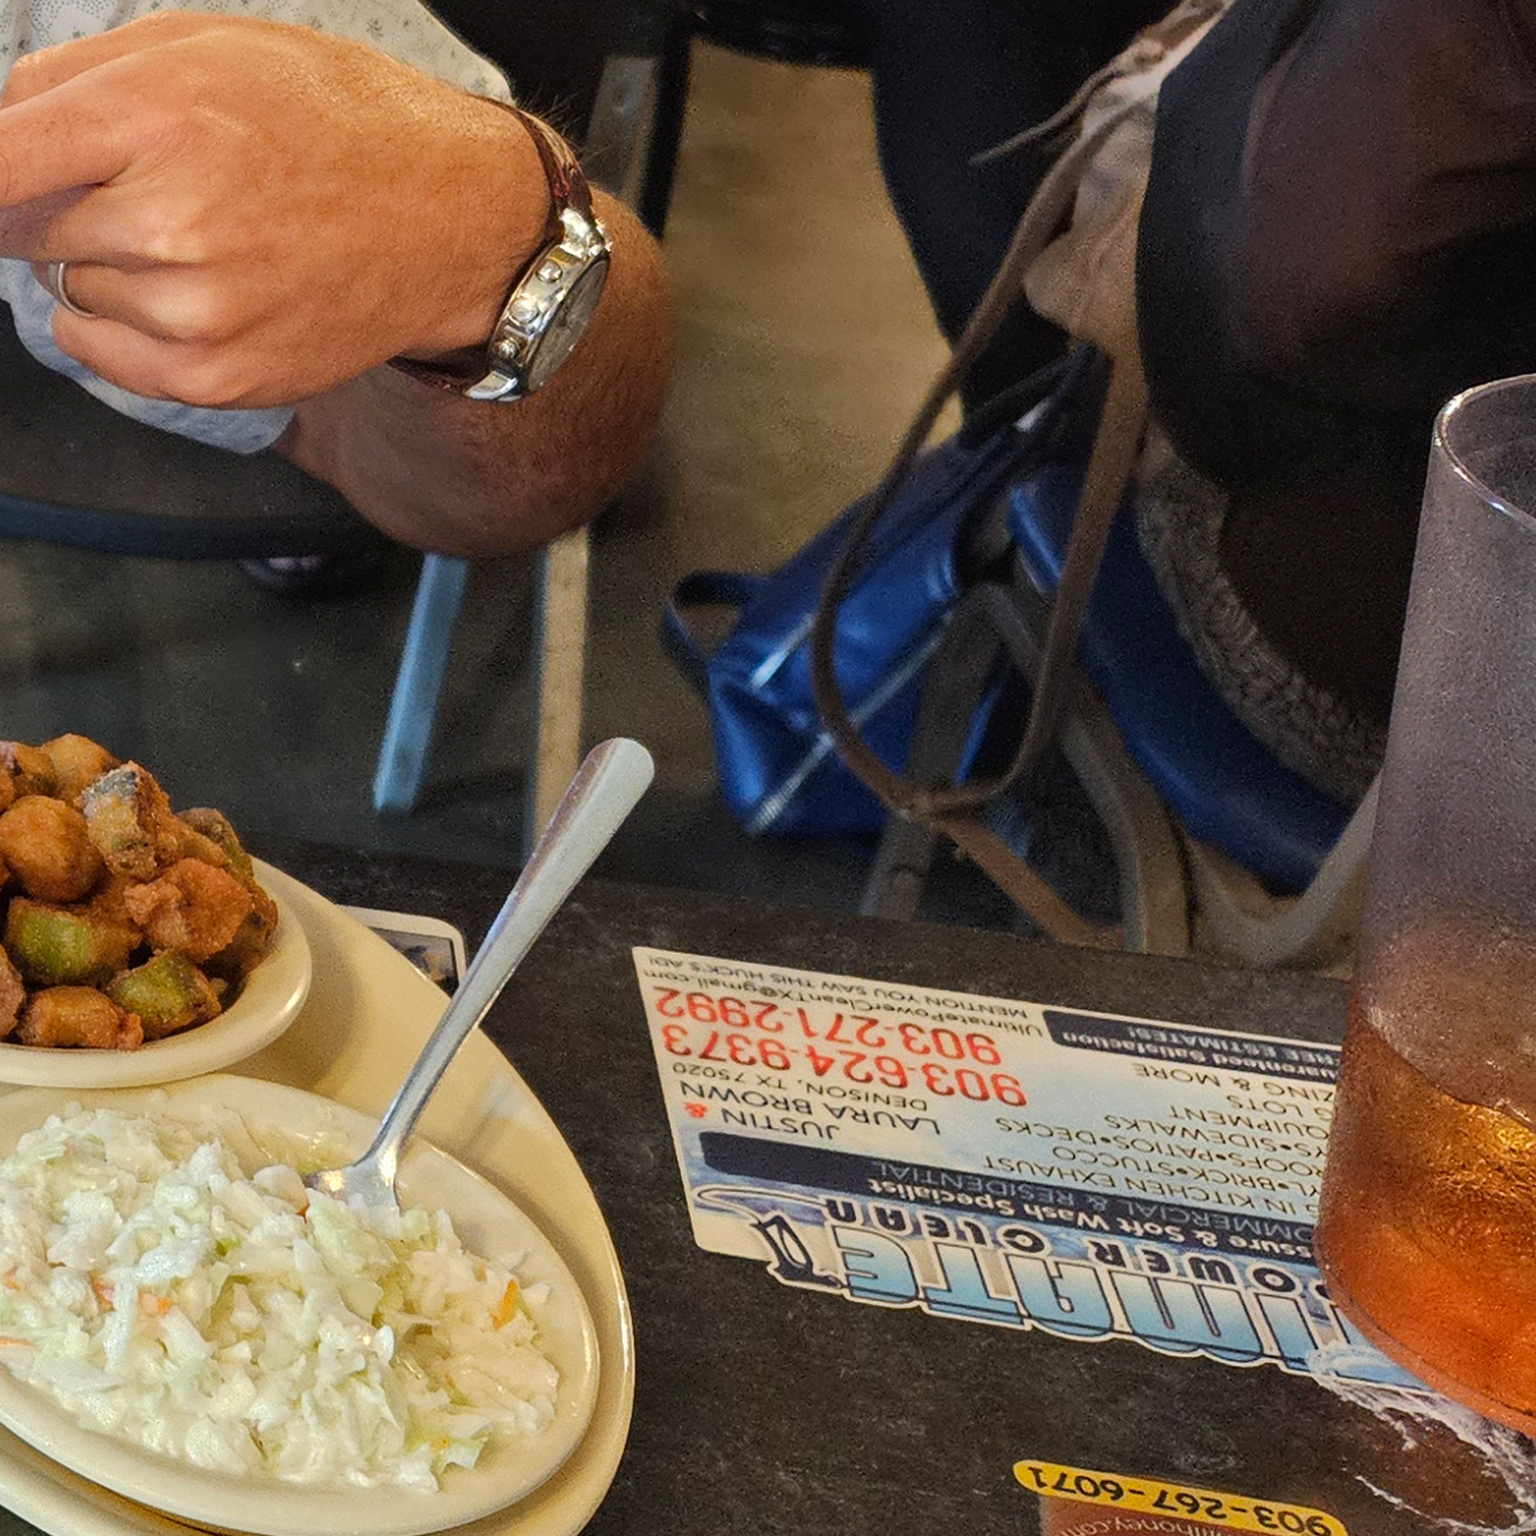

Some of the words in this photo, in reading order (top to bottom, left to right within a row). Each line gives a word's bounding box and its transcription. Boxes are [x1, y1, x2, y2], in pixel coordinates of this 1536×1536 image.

[690, 960, 763, 985] HUCK'S
[769, 973, 812, 989] THIS
[821, 980, 867, 996] SAW
[874, 988, 921, 1004] YOU
[643, 969, 1042, 1038] UltimatePowerCleanTX@gmail.com
[925, 995, 1028, 1019] MENTION
[652, 986, 1002, 1065] 903-271-2992
[1061, 1031, 1206, 1063] Satisfaction
[661, 1024, 1027, 1108] 903-624-9373
[672, 1062, 745, 1084] 75020
[1131, 1063, 1221, 1088] MORE
[1212, 1053, 1335, 1079] uaranteed
[756, 1074, 786, 1090] TX
[797, 1079, 928, 1112] DENISON,
[1230, 1076, 1250, 1092] &
[679, 1080, 812, 1116] BROWN
[684, 1102, 708, 1119] &
[1226, 1094, 1303, 1118] LOTS
[721, 1107, 840, 1140] JUSTIN
[822, 1102, 941, 1135] LAURA
[1168, 1105, 1329, 1141] QUIPMENT
[872, 1160, 1075, 1207] RESIDENTIAL
[983, 1155, 1116, 1188] EXHAUST
[867, 1177, 1016, 1217] Specialist
[1087, 1195, 1107, 1211] &
[1124, 1176, 1256, 1210] KITCHEN
[1264, 1198, 1296, 1216] IN
[825, 1198, 1045, 1254] CLEAN
[1023, 1203, 1110, 1232] Wash
[1116, 1199, 1313, 1243] OMMERCIAL
[1116, 1217, 1185, 1243] Soft
[1191, 1229, 1218, 1248] &
[1027, 1467, 1331, 1536] 903-267-6071
